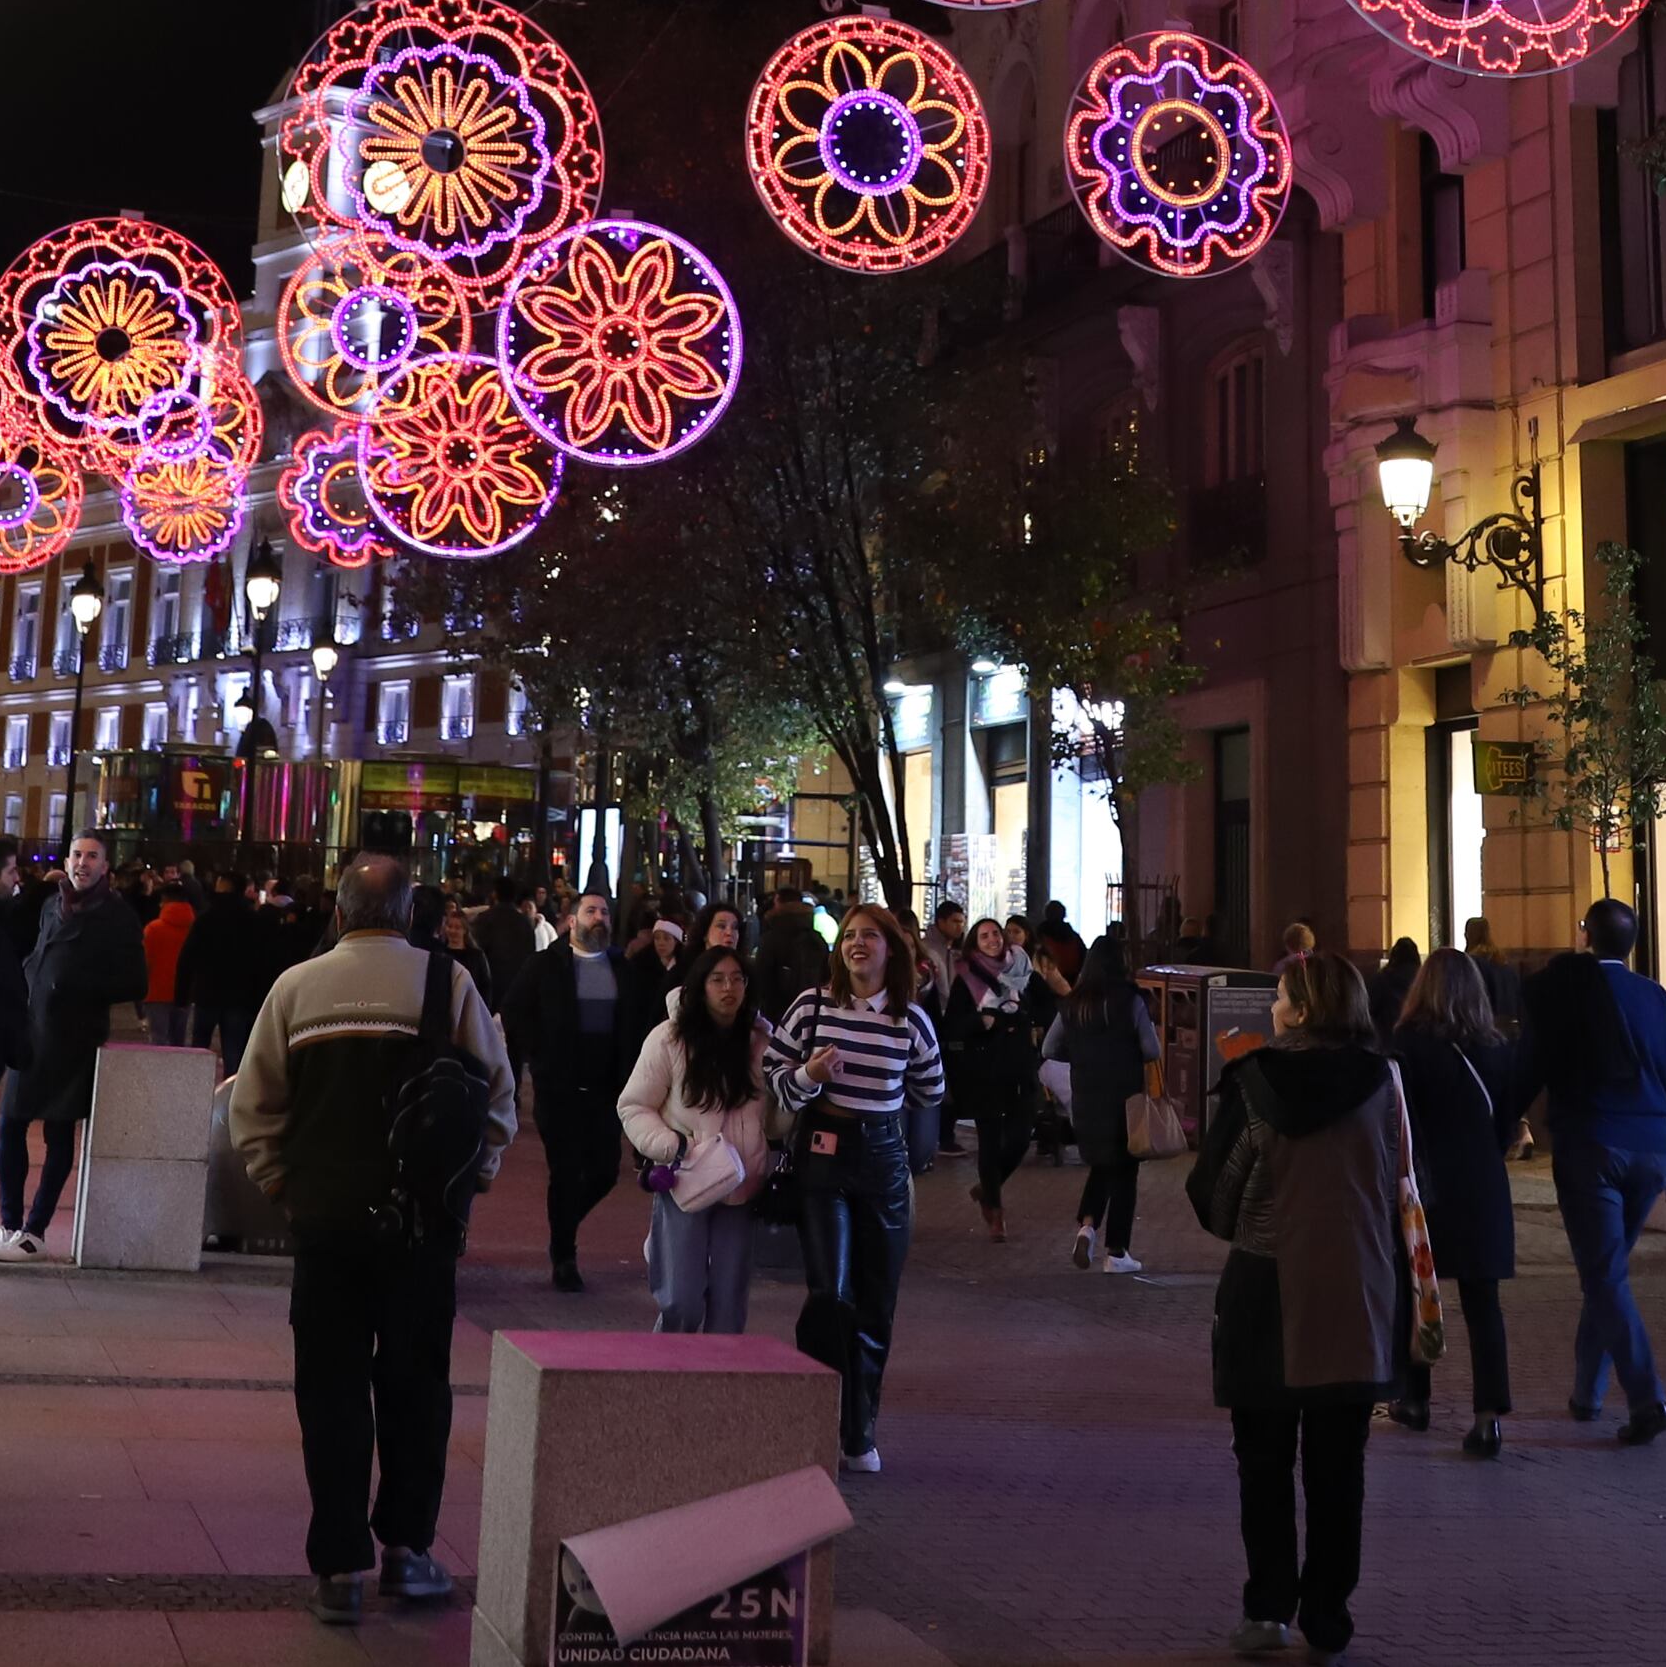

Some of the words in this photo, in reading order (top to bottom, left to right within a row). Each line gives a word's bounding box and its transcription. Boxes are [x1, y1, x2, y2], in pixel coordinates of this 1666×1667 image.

[709, 1587, 798, 1620] 25N
[559, 1632, 604, 1642] CONTRA
[683, 1631, 717, 1641] HACIA
[720, 1631, 740, 1640] LAS
[558, 1648, 624, 1662] UNIDAD
[629, 1647, 731, 1661] CIUDADANA
